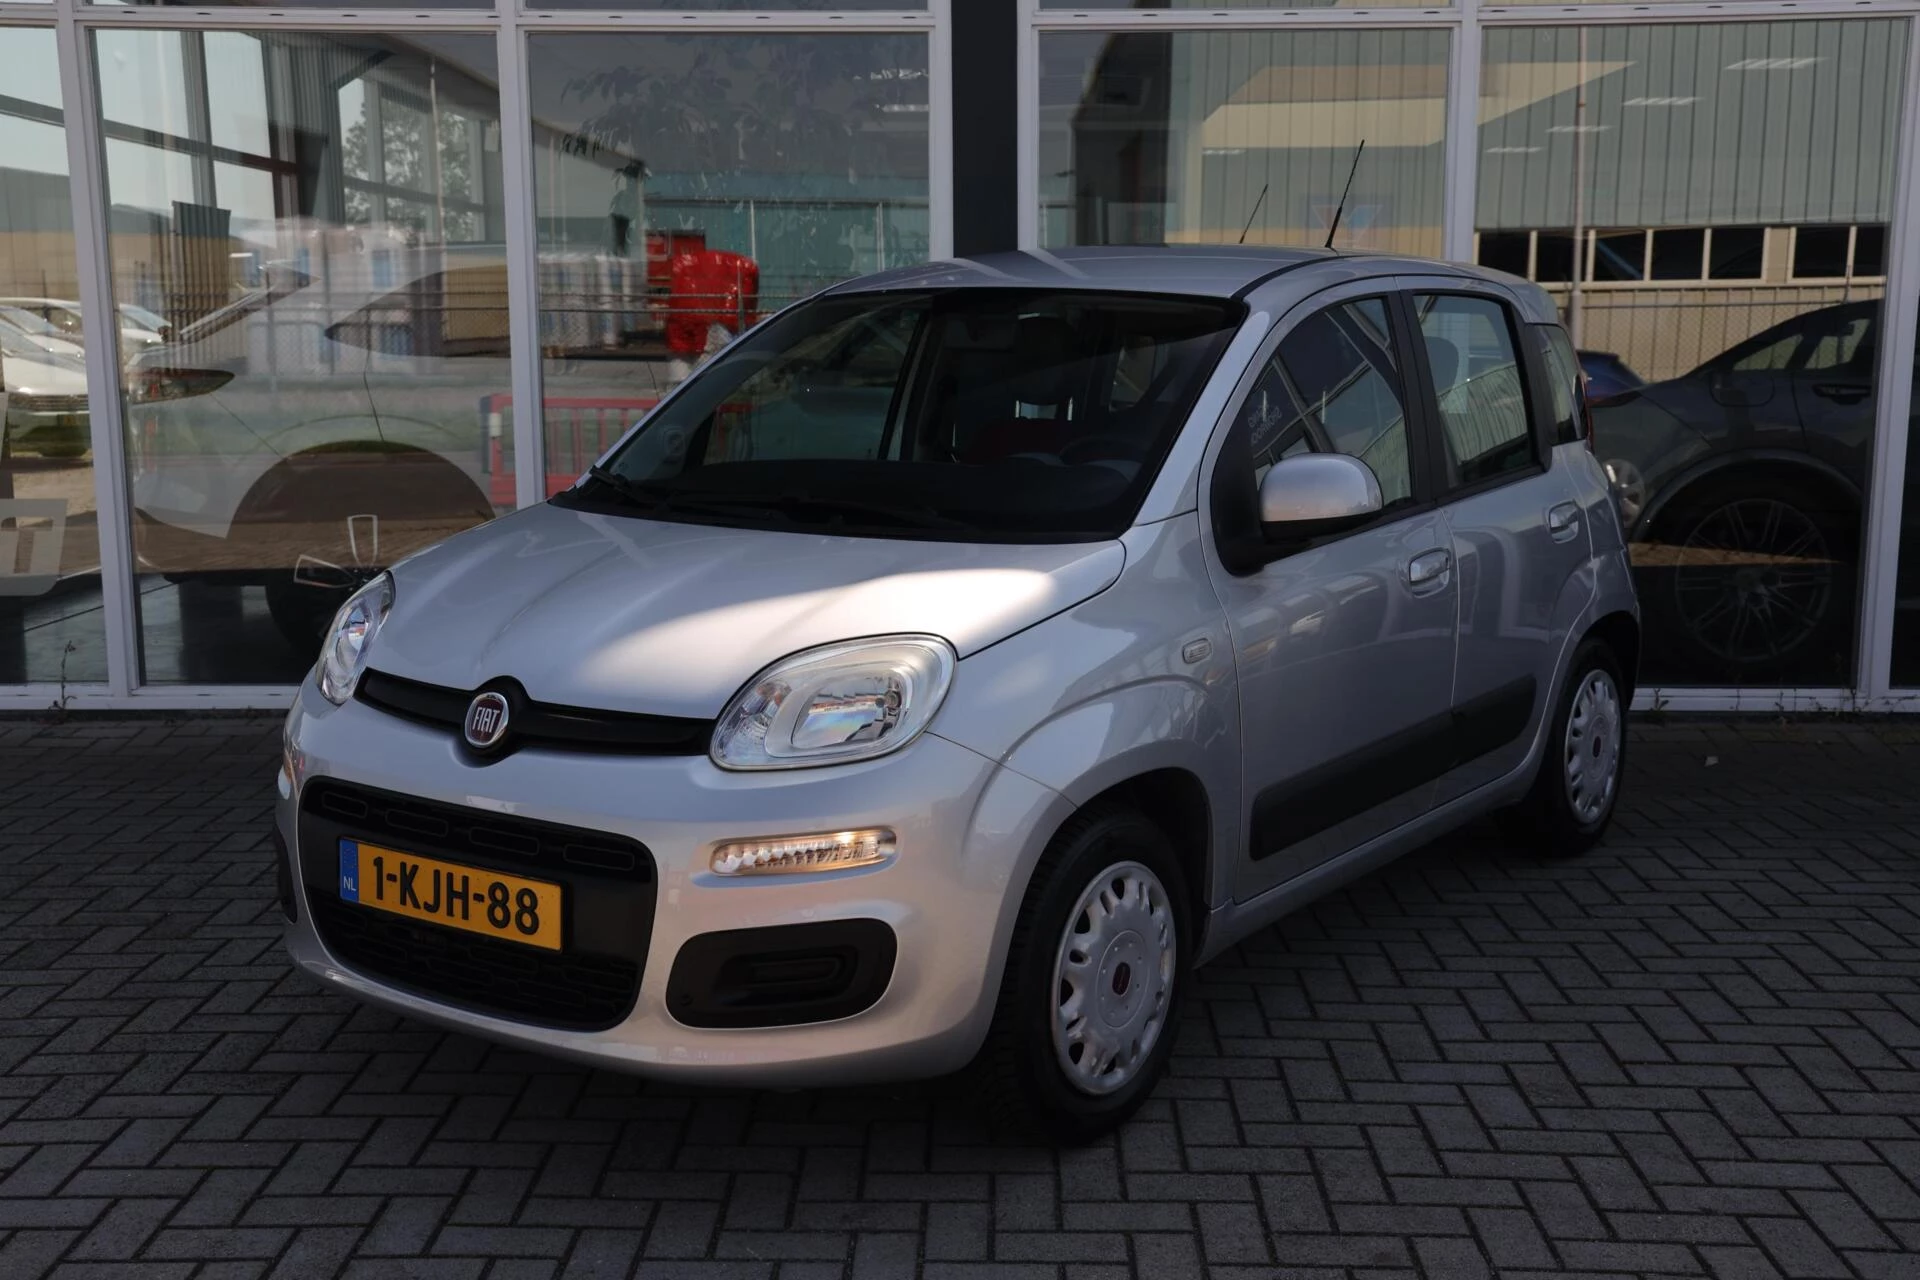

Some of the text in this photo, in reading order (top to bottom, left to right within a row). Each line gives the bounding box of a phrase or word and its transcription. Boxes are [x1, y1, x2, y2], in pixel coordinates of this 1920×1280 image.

[472, 706, 500, 733] FIAT
[343, 876, 357, 891] NL
[373, 856, 540, 935] 1-KJH-88
